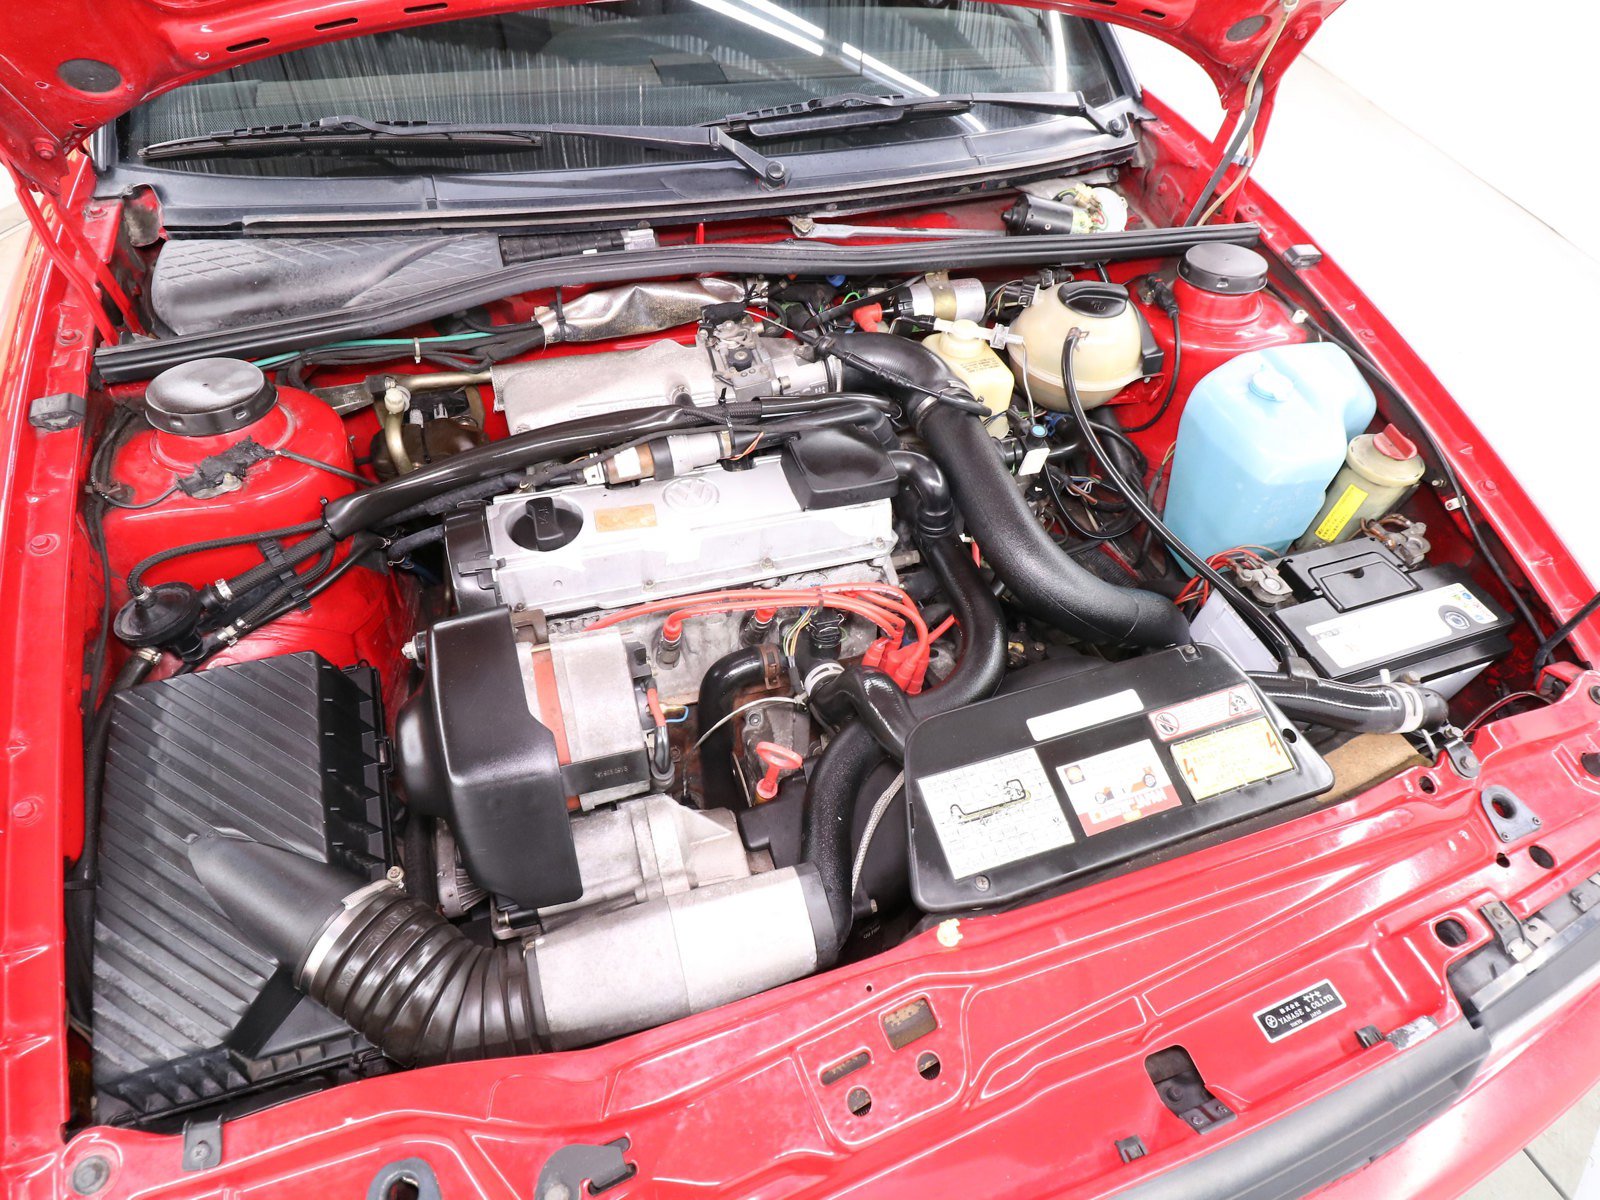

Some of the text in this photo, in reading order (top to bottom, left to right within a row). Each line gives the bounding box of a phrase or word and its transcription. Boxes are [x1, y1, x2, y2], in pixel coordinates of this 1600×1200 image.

[1303, 990, 1321, 1002] ヤナセ
[1278, 1009, 1304, 1024] YANASE
[1310, 1010, 1321, 1018] JAPAN
